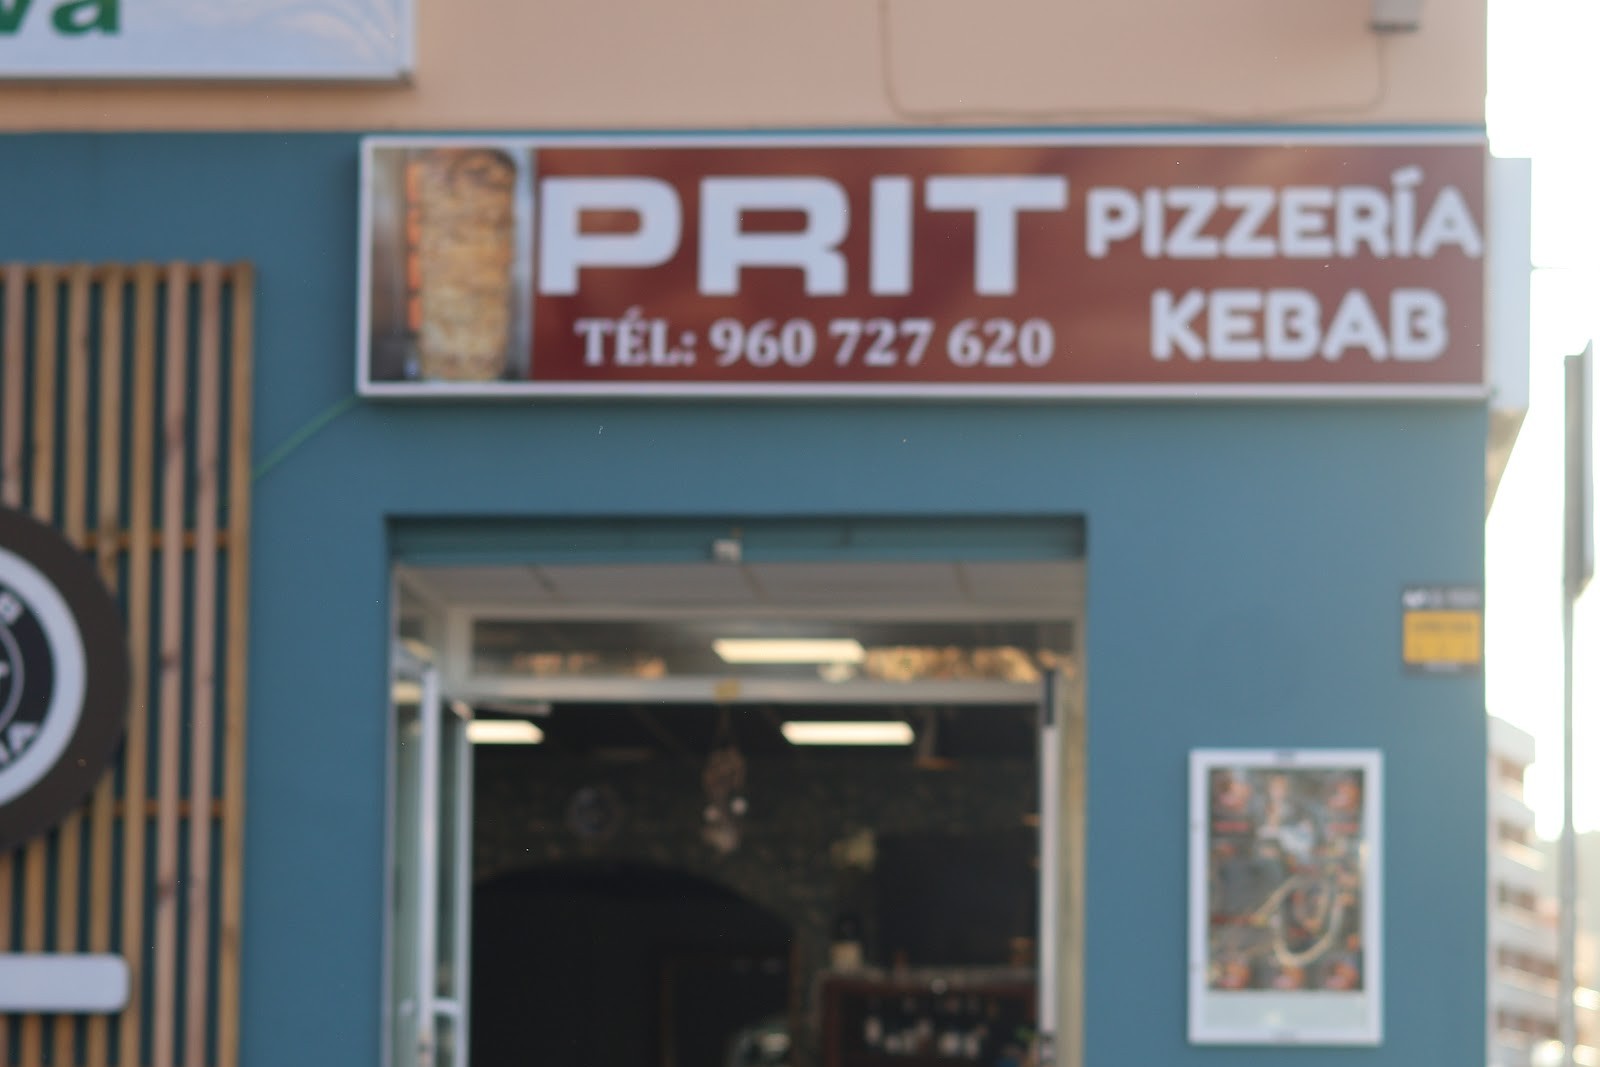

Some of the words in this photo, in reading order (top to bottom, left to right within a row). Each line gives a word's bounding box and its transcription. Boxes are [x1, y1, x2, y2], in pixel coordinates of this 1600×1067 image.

[538, 175, 1067, 296] PRIT
[1086, 166, 1483, 259] PIZZERÍA
[574, 307, 697, 367] TÉL:
[709, 319, 817, 368] 960
[828, 319, 935, 367] 727
[947, 319, 1055, 368] 620
[1150, 289, 1448, 361] KEBAB
